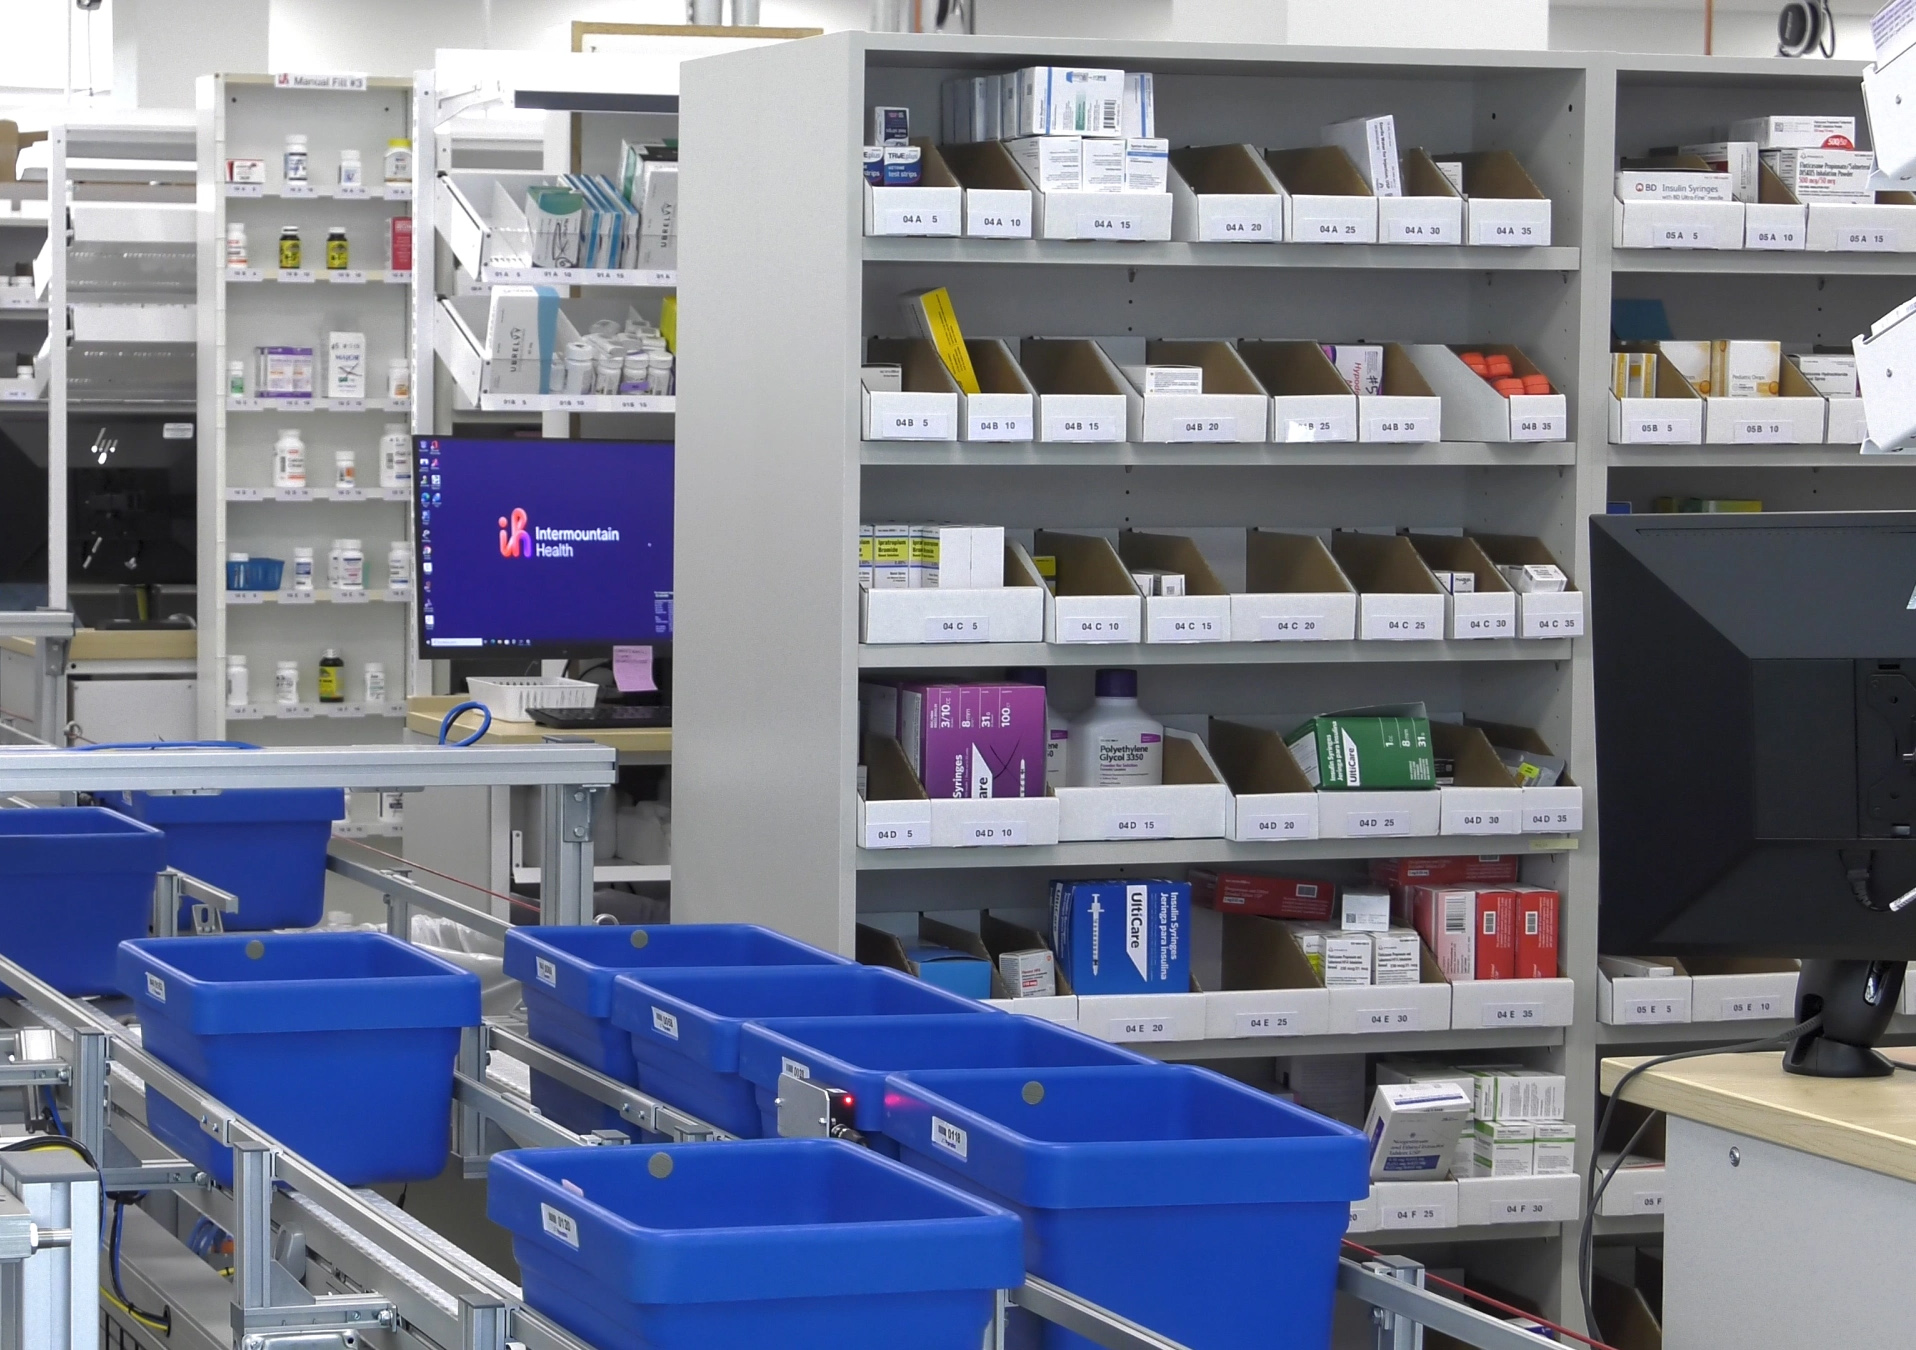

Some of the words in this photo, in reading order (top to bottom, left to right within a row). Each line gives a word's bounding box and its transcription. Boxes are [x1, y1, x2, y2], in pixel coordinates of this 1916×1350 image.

[294, 76, 328, 86] Manual
[332, 78, 347, 87] Fill
[350, 79, 362, 88] #3
[1662, 184, 1686, 192] Insulin
[1688, 184, 1718, 194] Syringes
[902, 214, 915, 224] 04
[983, 217, 996, 226] 04
[1010, 218, 1022, 228] 10
[660, 203, 672, 248] UBRELVY
[1225, 223, 1237, 232] 04
[1250, 222, 1263, 232] 20
[1404, 225, 1416, 235] 04
[1429, 226, 1441, 236] 30
[1495, 226, 1508, 236] 04
[1520, 226, 1533, 236] 35
[1665, 231, 1677, 240] 05
[1758, 232, 1770, 242] 05
[1783, 233, 1794, 242] 10
[1849, 234, 1861, 243] 05
[1873, 234, 1885, 244] 15
[510, 327, 522, 372] UBRELVY
[895, 418, 908, 428] 04
[980, 421, 992, 431] 04
[1004, 421, 1016, 430] 10
[1185, 422, 1197, 432] 04
[1208, 422, 1220, 432] 20
[1381, 422, 1393, 432] 04
[1403, 422, 1416, 432] 30
[1521, 422, 1532, 431] 04
[1541, 422, 1552, 431] 35
[1641, 423, 1653, 433] 05
[1745, 424, 1757, 434] 05
[1769, 424, 1780, 434] 10
[536, 526, 620, 541] Intermountain
[536, 544, 574, 558] Health
[942, 621, 954, 631] 04
[1081, 622, 1093, 631] 04
[1108, 622, 1120, 631] 10
[1277, 621, 1289, 631] 04
[1303, 621, 1316, 631] 20
[1538, 620, 1550, 629] 04
[1564, 619, 1576, 628] 35
[1332, 720, 1340, 744] insulina
[1100, 745, 1148, 755] Polyethylene
[1326, 734, 1335, 760] Syringes
[1099, 753, 1124, 763] Glycol
[1336, 758, 1344, 782] Jeringa
[1348, 748, 1357, 783] UltiCare
[952, 754, 964, 798] Syringes
[1328, 761, 1336, 782] Insulin
[1358, 818, 1371, 828] 04
[1383, 818, 1395, 828] 25
[1532, 815, 1544, 824] 04
[1556, 814, 1568, 823] 35
[1118, 821, 1130, 831] 04
[1143, 820, 1155, 830] 15
[877, 830, 890, 840] 04
[974, 829, 987, 838] 04
[1001, 828, 1013, 837] 10
[1158, 892, 1169, 924] Jeringa
[1170, 892, 1179, 921] Insulin
[1130, 892, 1143, 949] UltiCare
[1158, 925, 1167, 945] para
[1169, 922, 1179, 960] Syringes
[1160, 946, 1169, 980] insulina
[1496, 1010, 1508, 1020] 04
[1522, 1009, 1534, 1019] 35
[1636, 1005, 1648, 1015] 05
[1250, 1018, 1262, 1028] 04
[1276, 1017, 1288, 1027] 25
[1125, 1024, 1137, 1034] 04
[1151, 1023, 1164, 1033] 20
[947, 1128, 961, 1144] 0118
[1643, 1197, 1655, 1207] 05
[1506, 1204, 1518, 1214] 04
[1532, 1204, 1544, 1213] 30
[1396, 1210, 1409, 1220] 04
[1423, 1209, 1435, 1219] 25
